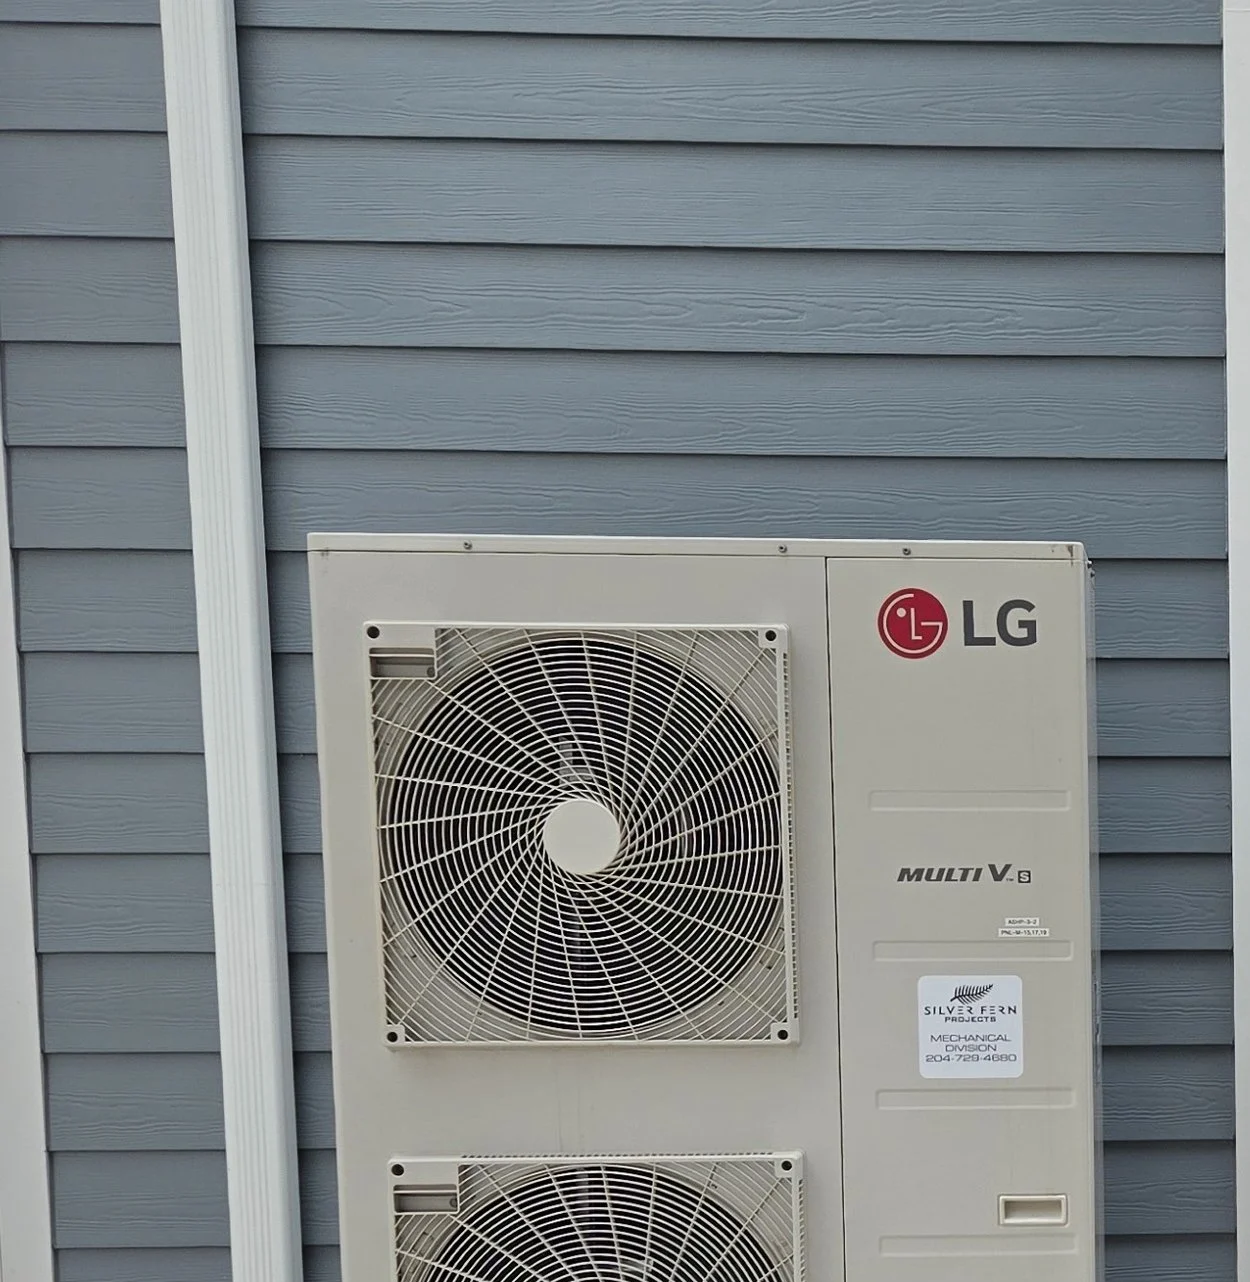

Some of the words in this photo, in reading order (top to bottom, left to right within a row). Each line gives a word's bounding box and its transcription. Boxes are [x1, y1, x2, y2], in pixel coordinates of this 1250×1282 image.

[962, 599, 1037, 647] LG
[897, 867, 983, 882] MULTI
[924, 1005, 974, 1016] SILVER
[980, 1005, 1017, 1015] FERN
[930, 1034, 1012, 1043] MECHANICAL
[945, 1044, 997, 1052] DIVISION
[925, 1053, 1017, 1062] 204-729-4680
